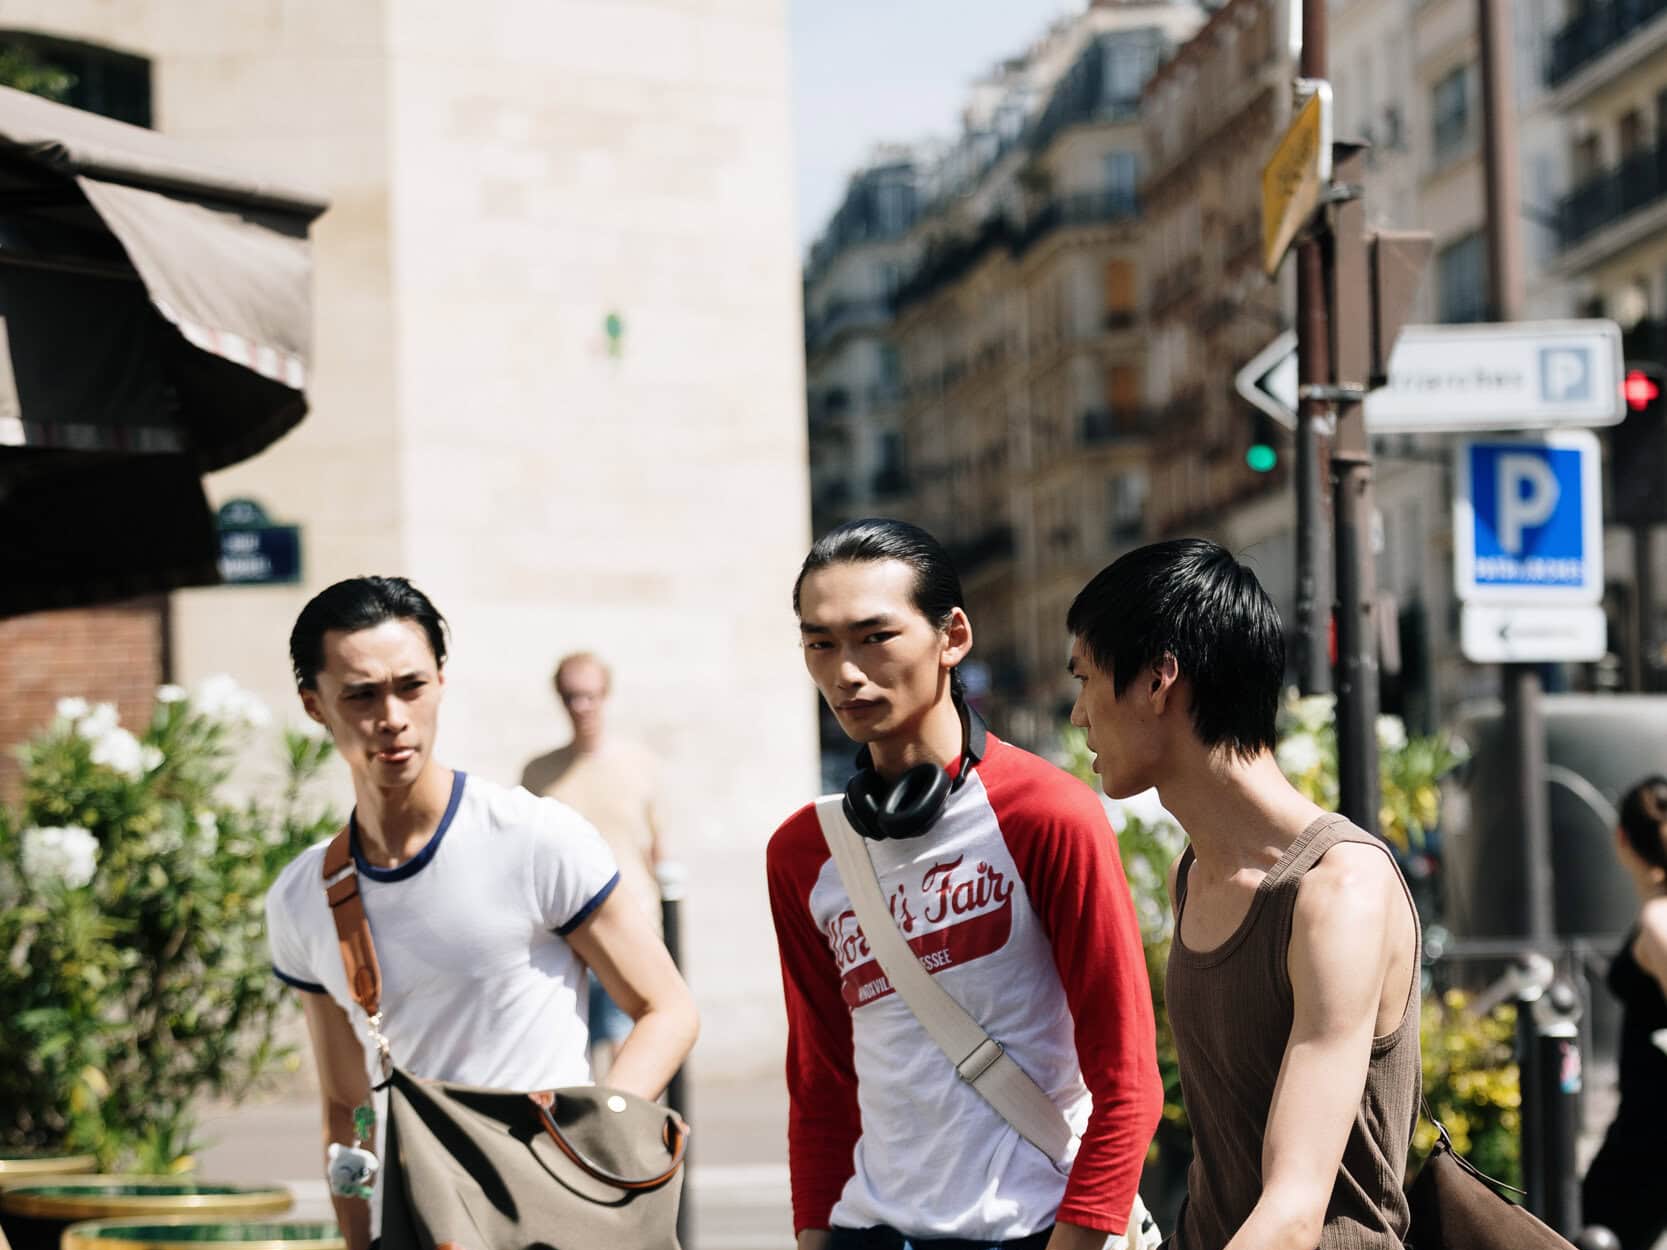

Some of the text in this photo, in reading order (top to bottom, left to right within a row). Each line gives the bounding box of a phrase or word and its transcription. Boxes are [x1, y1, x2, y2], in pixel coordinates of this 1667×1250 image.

[1548, 351, 1584, 400] P
[1496, 453, 1560, 554] P
[922, 854, 1015, 924] Fair
